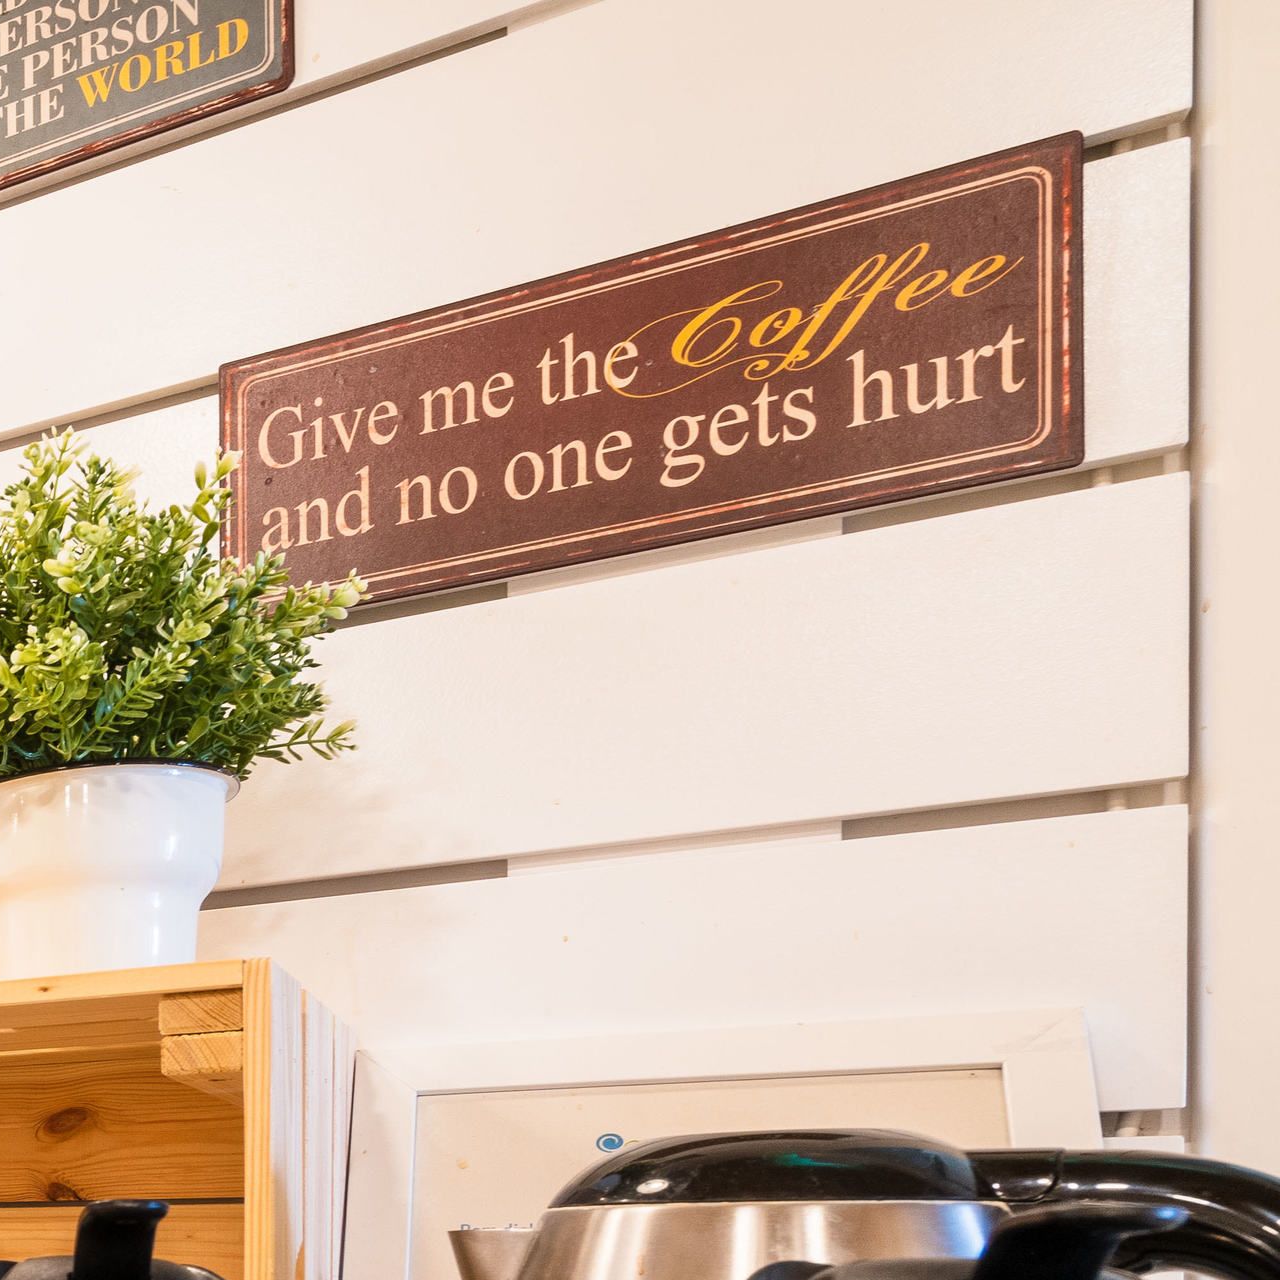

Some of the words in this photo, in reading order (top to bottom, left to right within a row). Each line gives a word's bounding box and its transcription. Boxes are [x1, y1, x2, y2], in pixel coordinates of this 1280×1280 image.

[21, 0, 200, 91] PERSON
[75, 18, 249, 108] WORLD
[258, 397, 399, 469] Give
[418, 371, 515, 436] me
[536, 333, 639, 406] the
[608, 242, 1025, 398] Coffee
[261, 465, 375, 552] and
[394, 465, 478, 526] no
[504, 426, 633, 501] one
[659, 381, 817, 488] gets
[845, 324, 1026, 429] hurt
